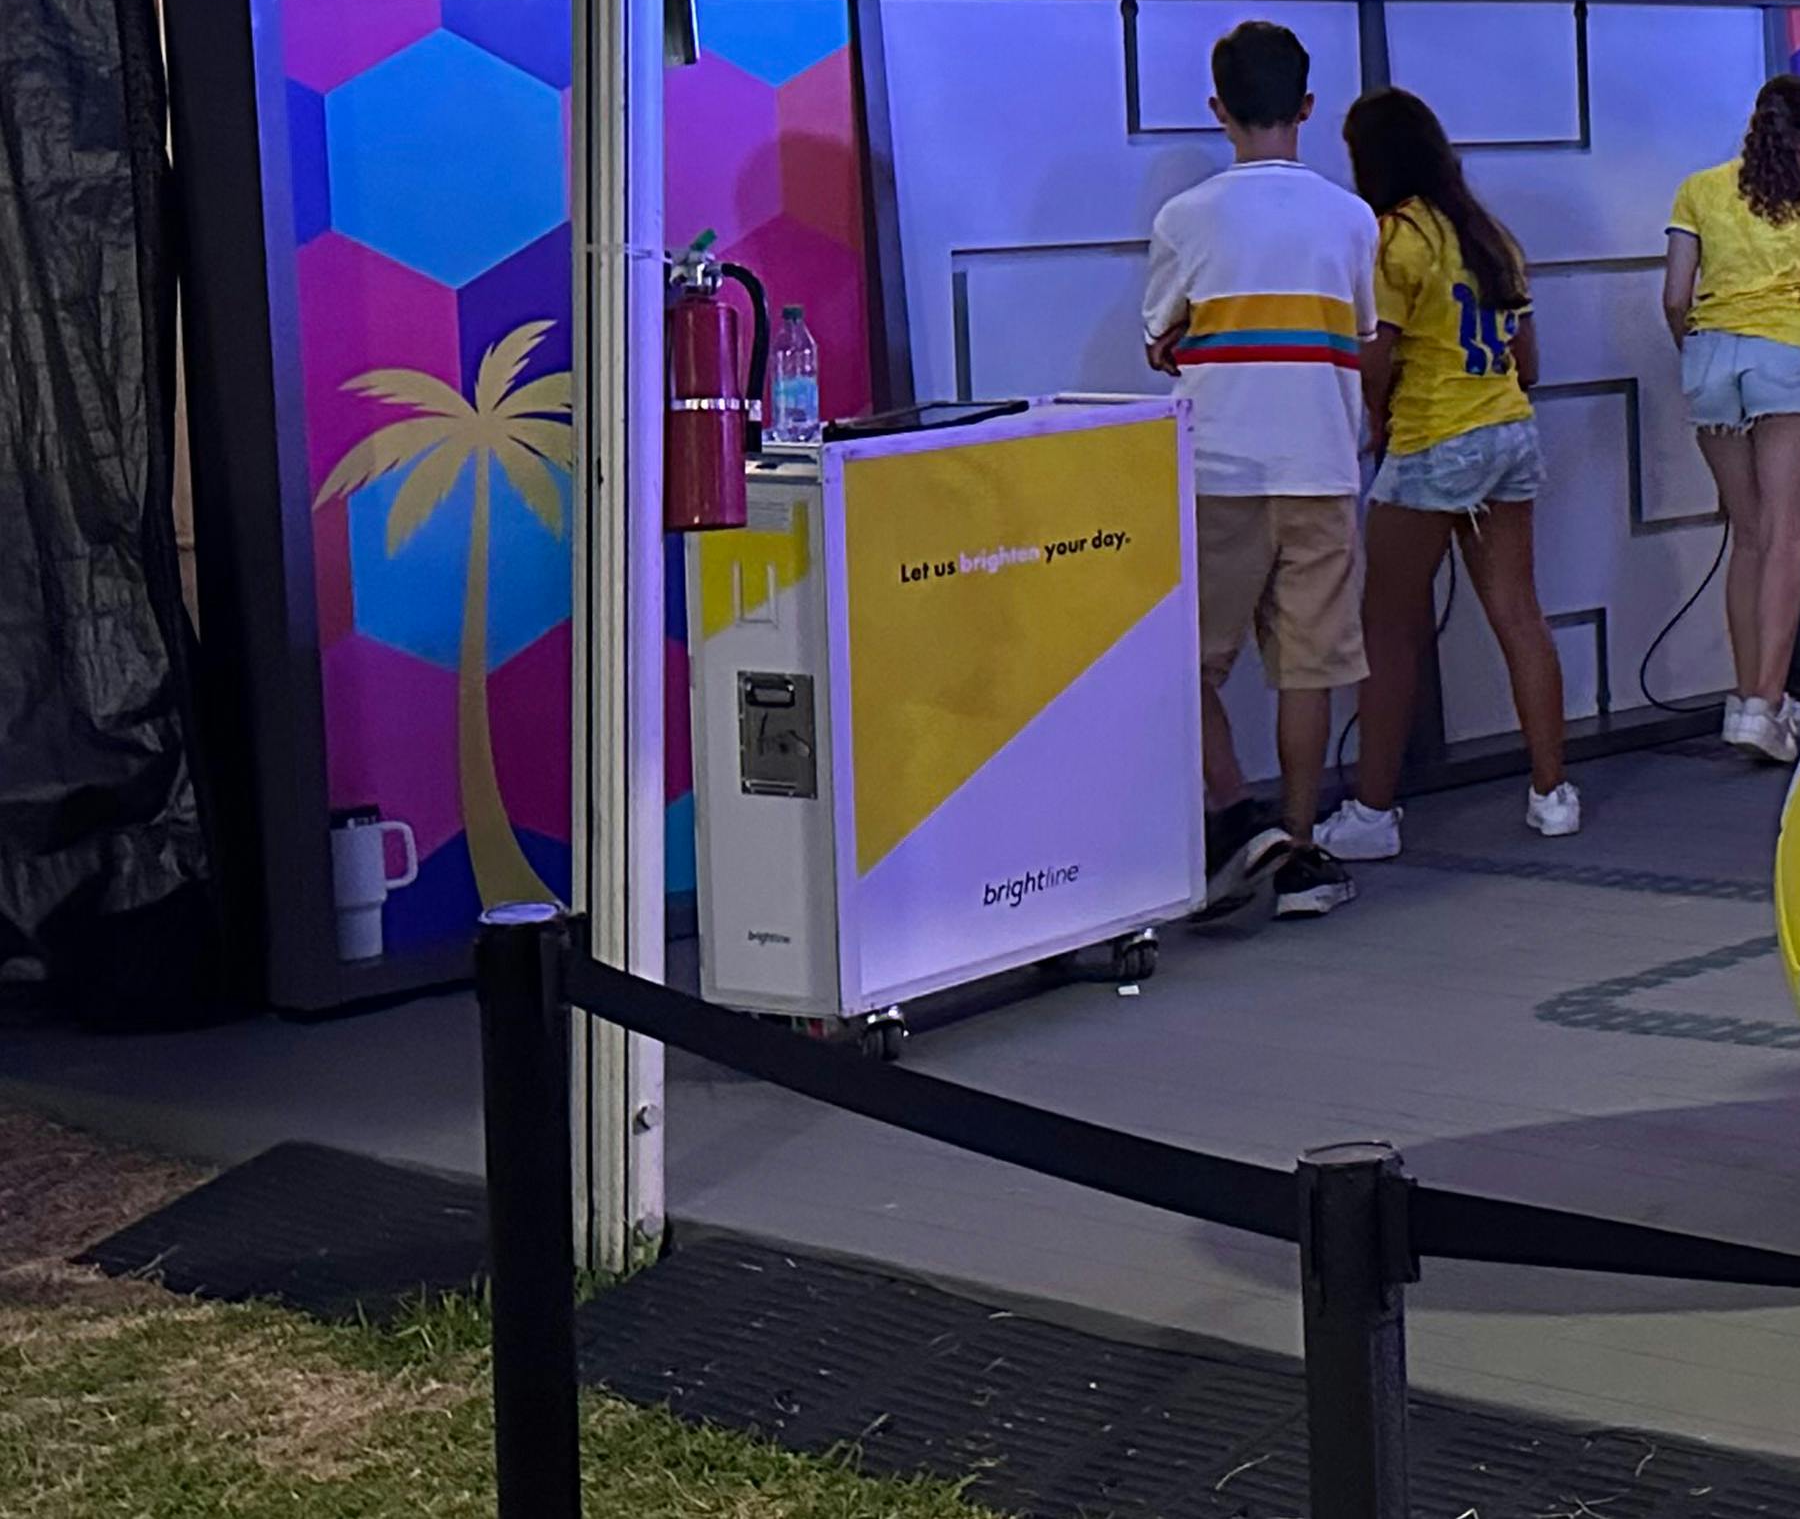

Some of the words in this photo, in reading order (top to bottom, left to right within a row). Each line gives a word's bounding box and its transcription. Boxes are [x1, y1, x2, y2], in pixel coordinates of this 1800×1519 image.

[900, 561, 929, 583] Let
[934, 559, 956, 578] us
[958, 544, 1040, 575] brighten
[1043, 536, 1088, 563] your
[1090, 528, 1131, 551] day.
[983, 864, 1080, 908] brightline
